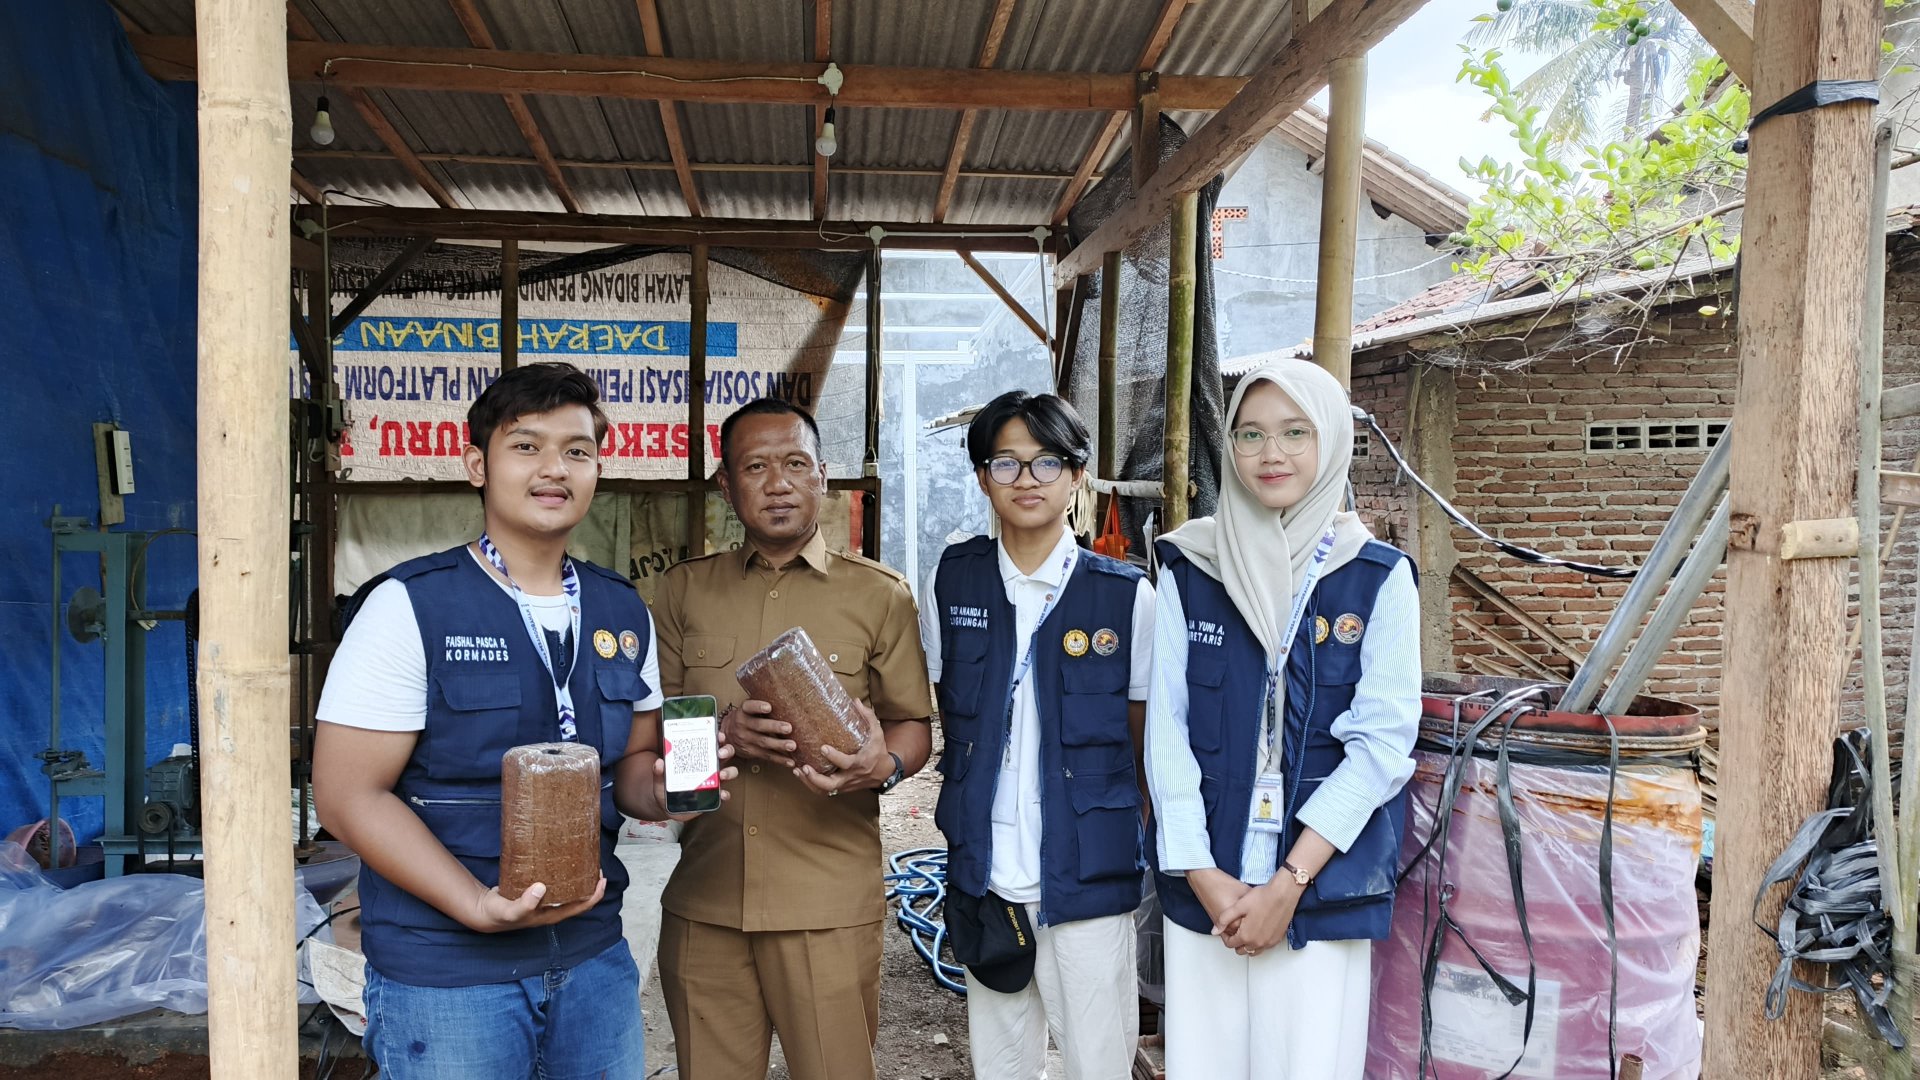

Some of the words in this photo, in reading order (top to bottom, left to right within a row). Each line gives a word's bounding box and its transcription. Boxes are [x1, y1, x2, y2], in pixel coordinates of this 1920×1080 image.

[581, 272, 640, 303] BIDANG
[360, 321, 499, 348] BINAAN
[517, 323, 668, 351] DAERAH
[344, 364, 461, 401] PLATFORM
[639, 367, 761, 405] SOSIAISASI
[767, 372, 812, 405] DAN
[599, 422, 689, 458] SEKO
[445, 635, 475, 648] FAISHAL
[476, 636, 499, 649] PASCA
[1199, 620, 1216, 633] YUNI
[1216, 624, 1225, 635] A.
[445, 649, 509, 662] KORMADES
